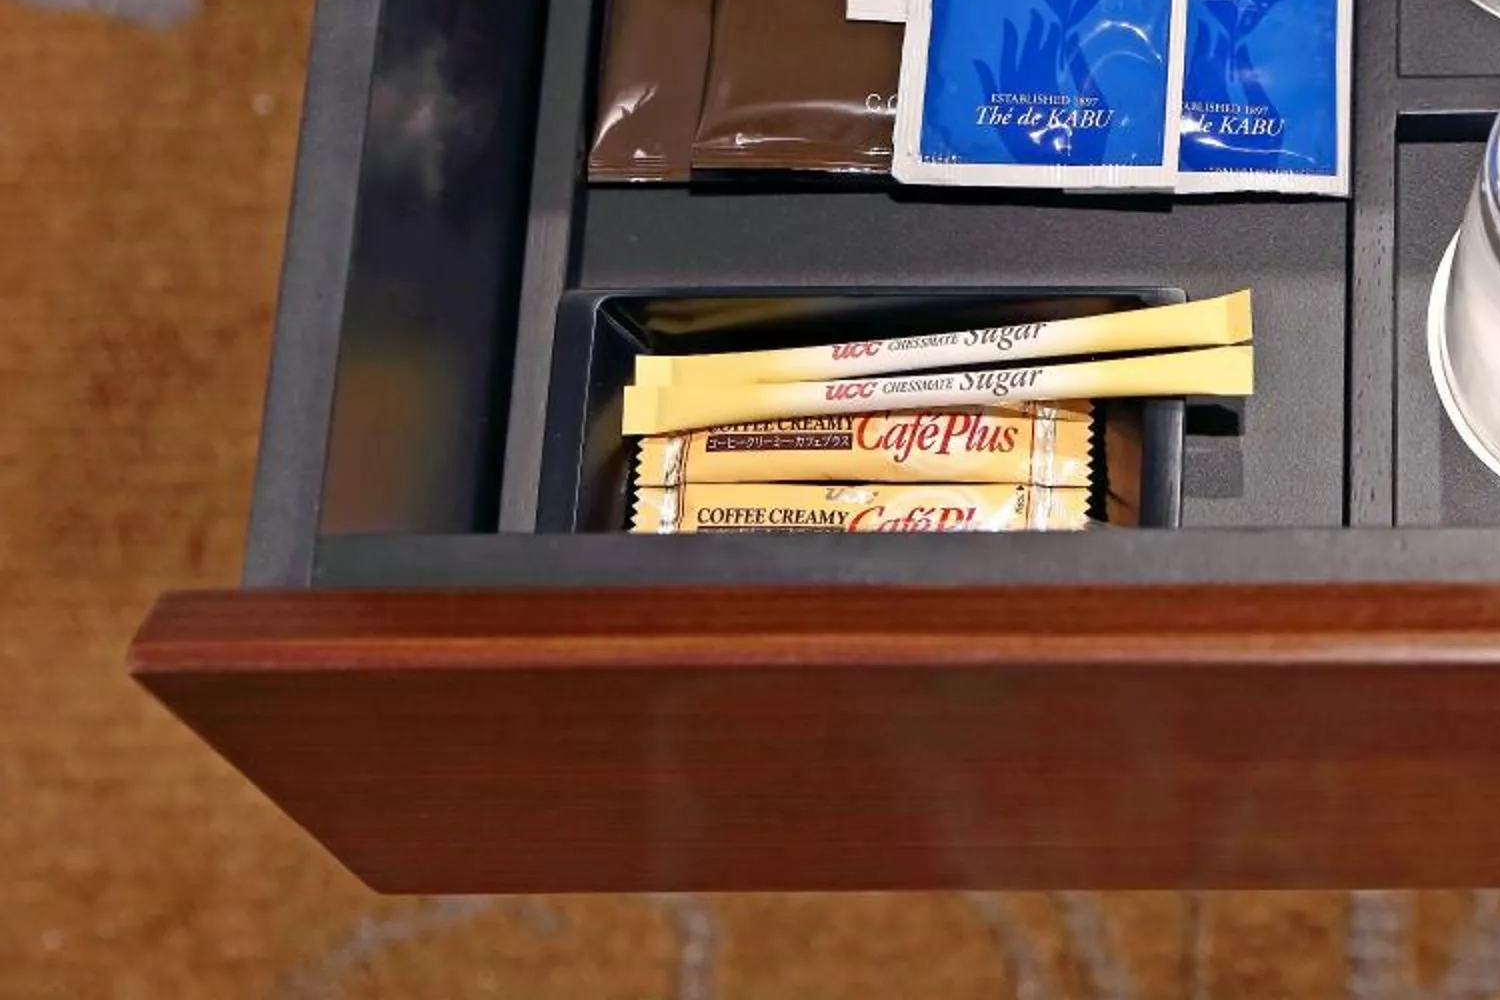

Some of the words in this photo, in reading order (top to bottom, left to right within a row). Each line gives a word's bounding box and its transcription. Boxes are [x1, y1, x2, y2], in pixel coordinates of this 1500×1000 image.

[991, 93, 1071, 105] ESTABLISHED
[976, 105, 1014, 127] Thé
[1017, 106, 1043, 126] de
[1047, 108, 1115, 129] KABU
[1219, 115, 1285, 137] KABU
[964, 322, 1048, 351] Sugar
[882, 378, 954, 394] CHESSMATE
[959, 369, 1044, 397] Sugar
[697, 507, 767, 525] COFFEE
[769, 508, 850, 525] CREAMY
